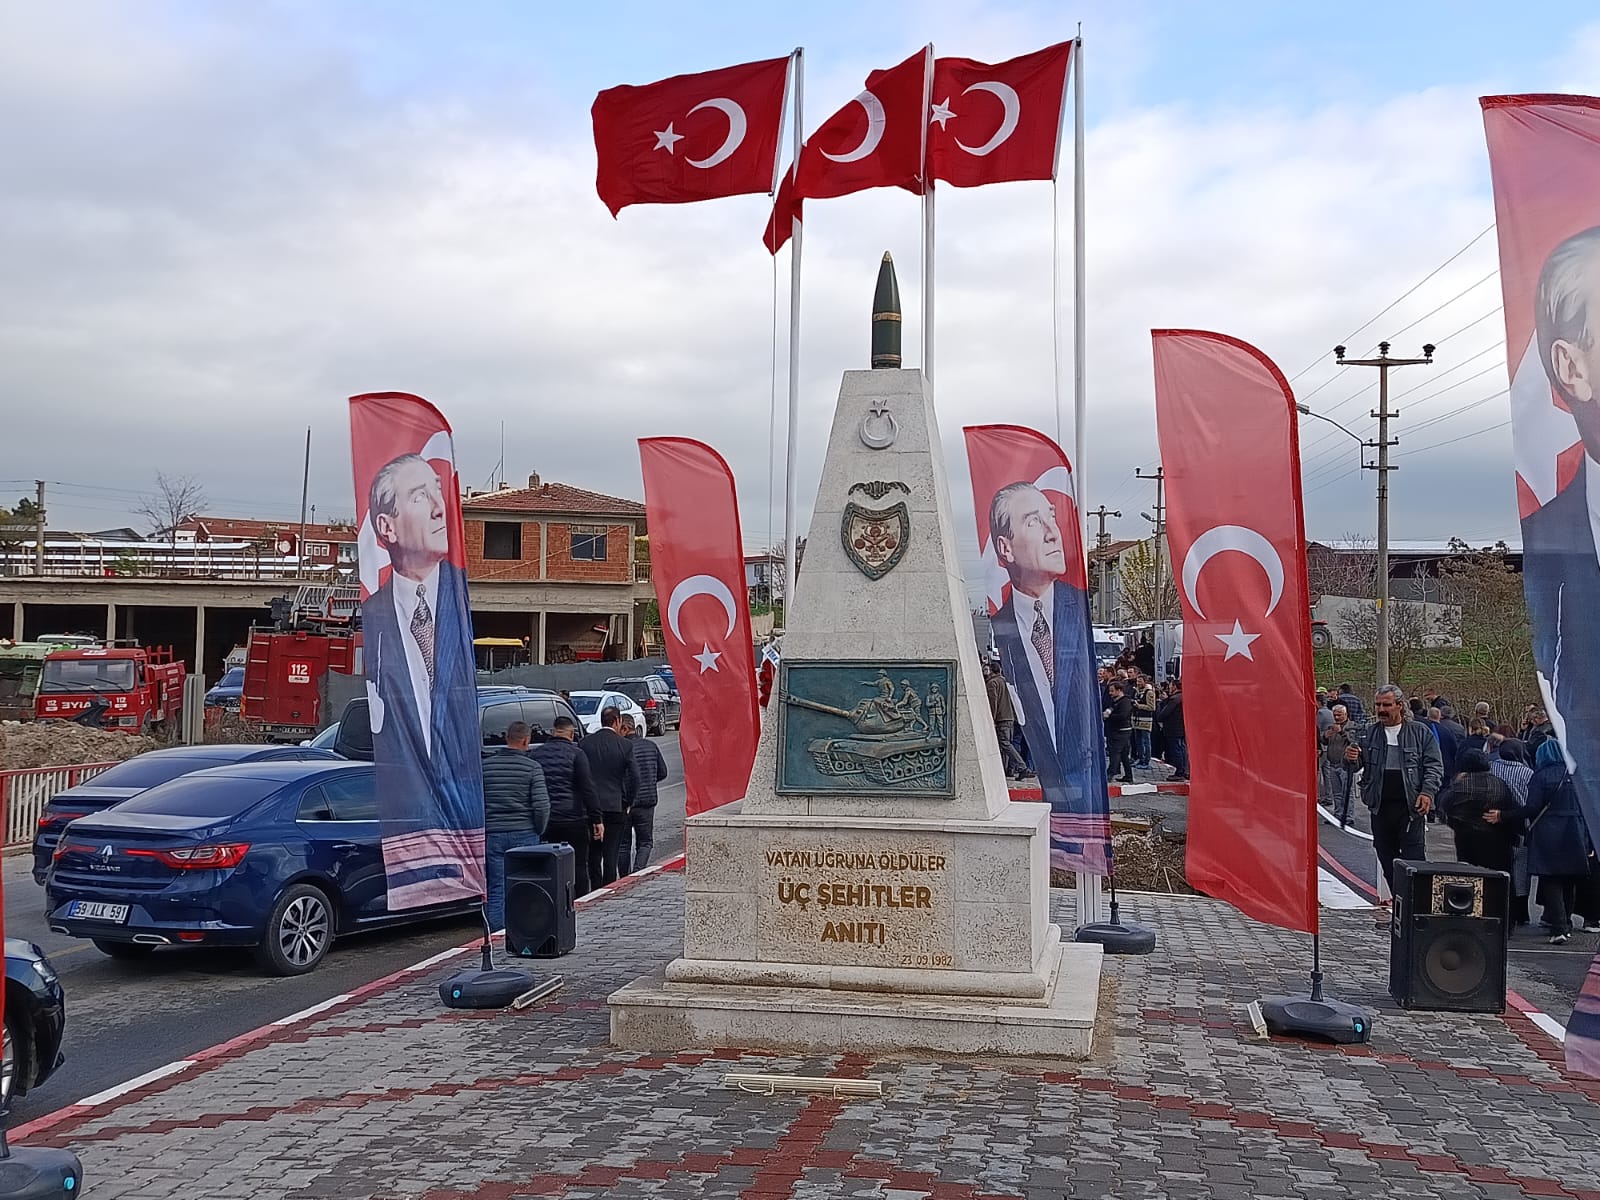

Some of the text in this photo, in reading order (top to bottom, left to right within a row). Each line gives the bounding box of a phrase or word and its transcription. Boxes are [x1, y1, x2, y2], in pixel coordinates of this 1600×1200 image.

[291, 664, 308, 675] 112
[766, 851, 811, 867] VATAN
[879, 851, 946, 871] ÖLDÜLER
[778, 877, 932, 911] ÜÇ ŞEHİTLER
[76, 902, 127, 920] 59 ALK 591
[821, 921, 885, 944] ANITI
